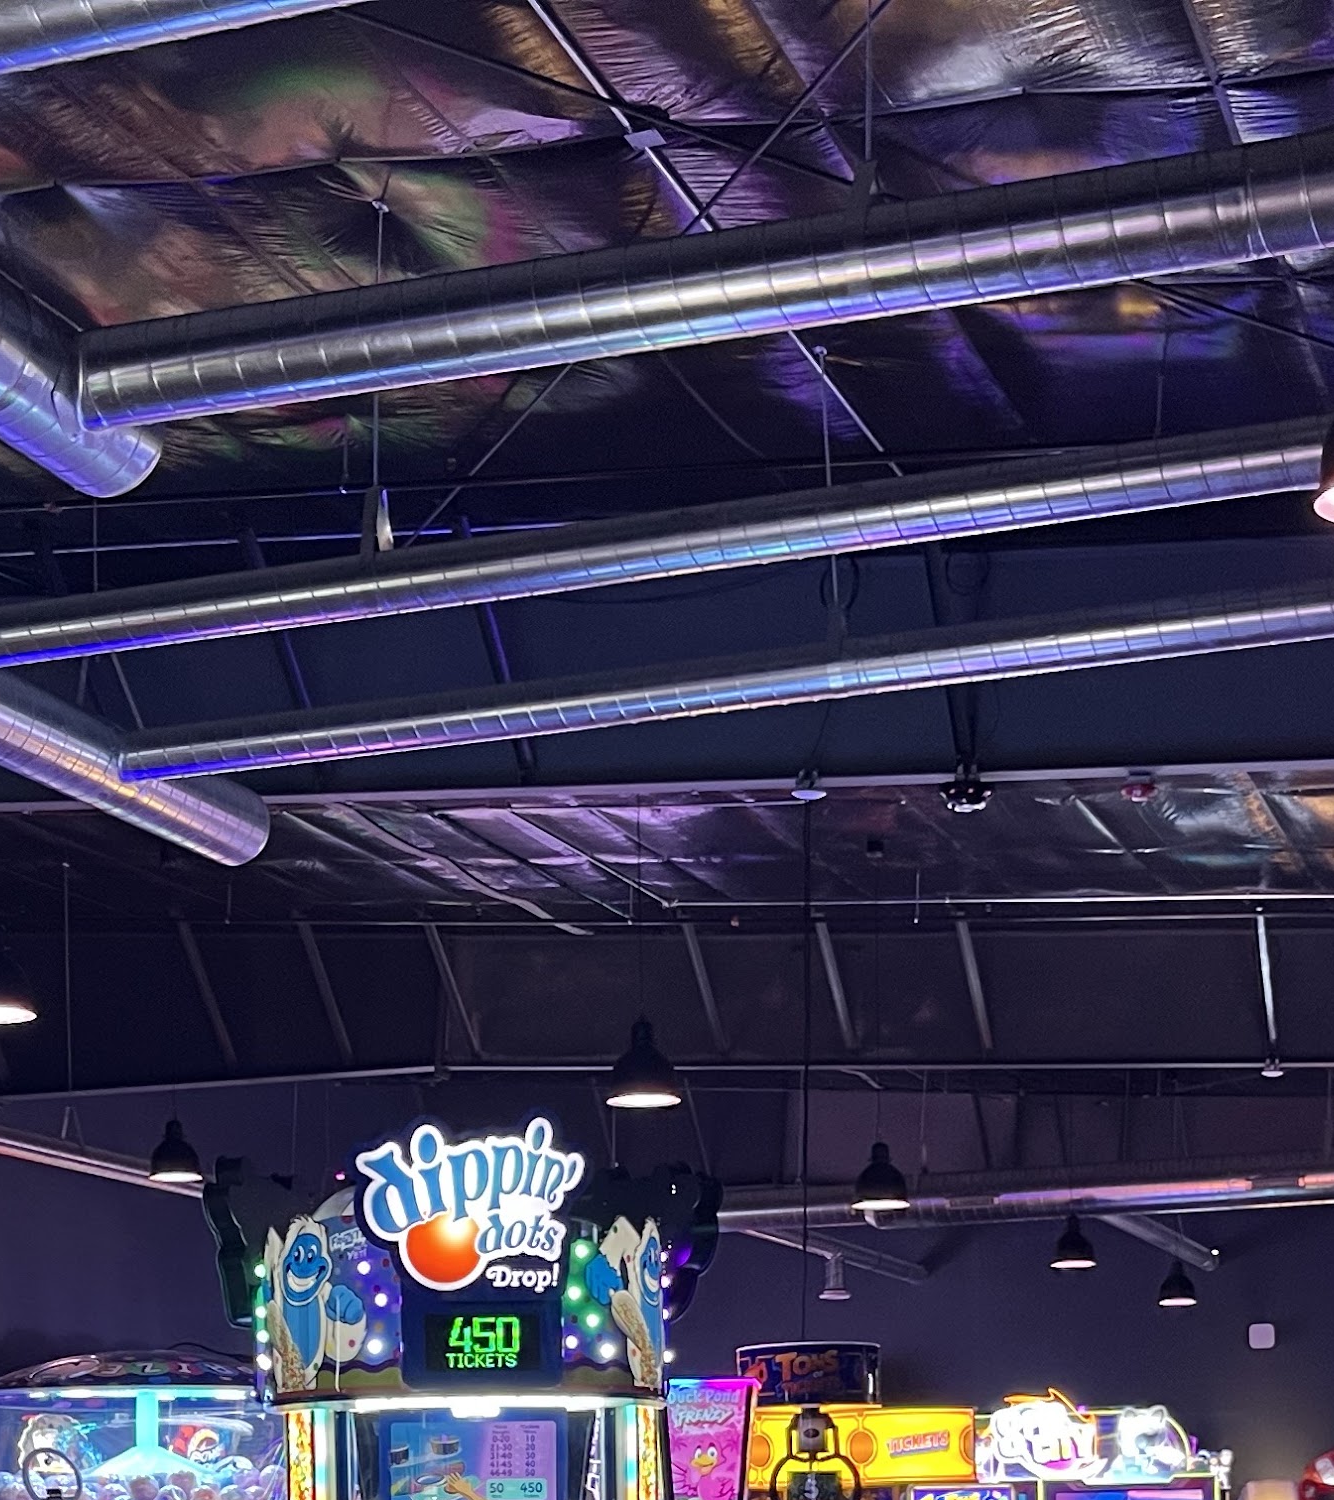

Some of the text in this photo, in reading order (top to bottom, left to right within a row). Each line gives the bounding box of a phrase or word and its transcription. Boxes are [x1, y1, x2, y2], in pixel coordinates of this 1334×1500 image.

[364, 1124, 577, 1234] dippin'
[477, 1213, 560, 1254] dots
[486, 1263, 560, 1293] Drop!
[448, 1316, 521, 1354] 450
[445, 1353, 518, 1369] TICKETS
[489, 1482, 543, 1494] 50 450
